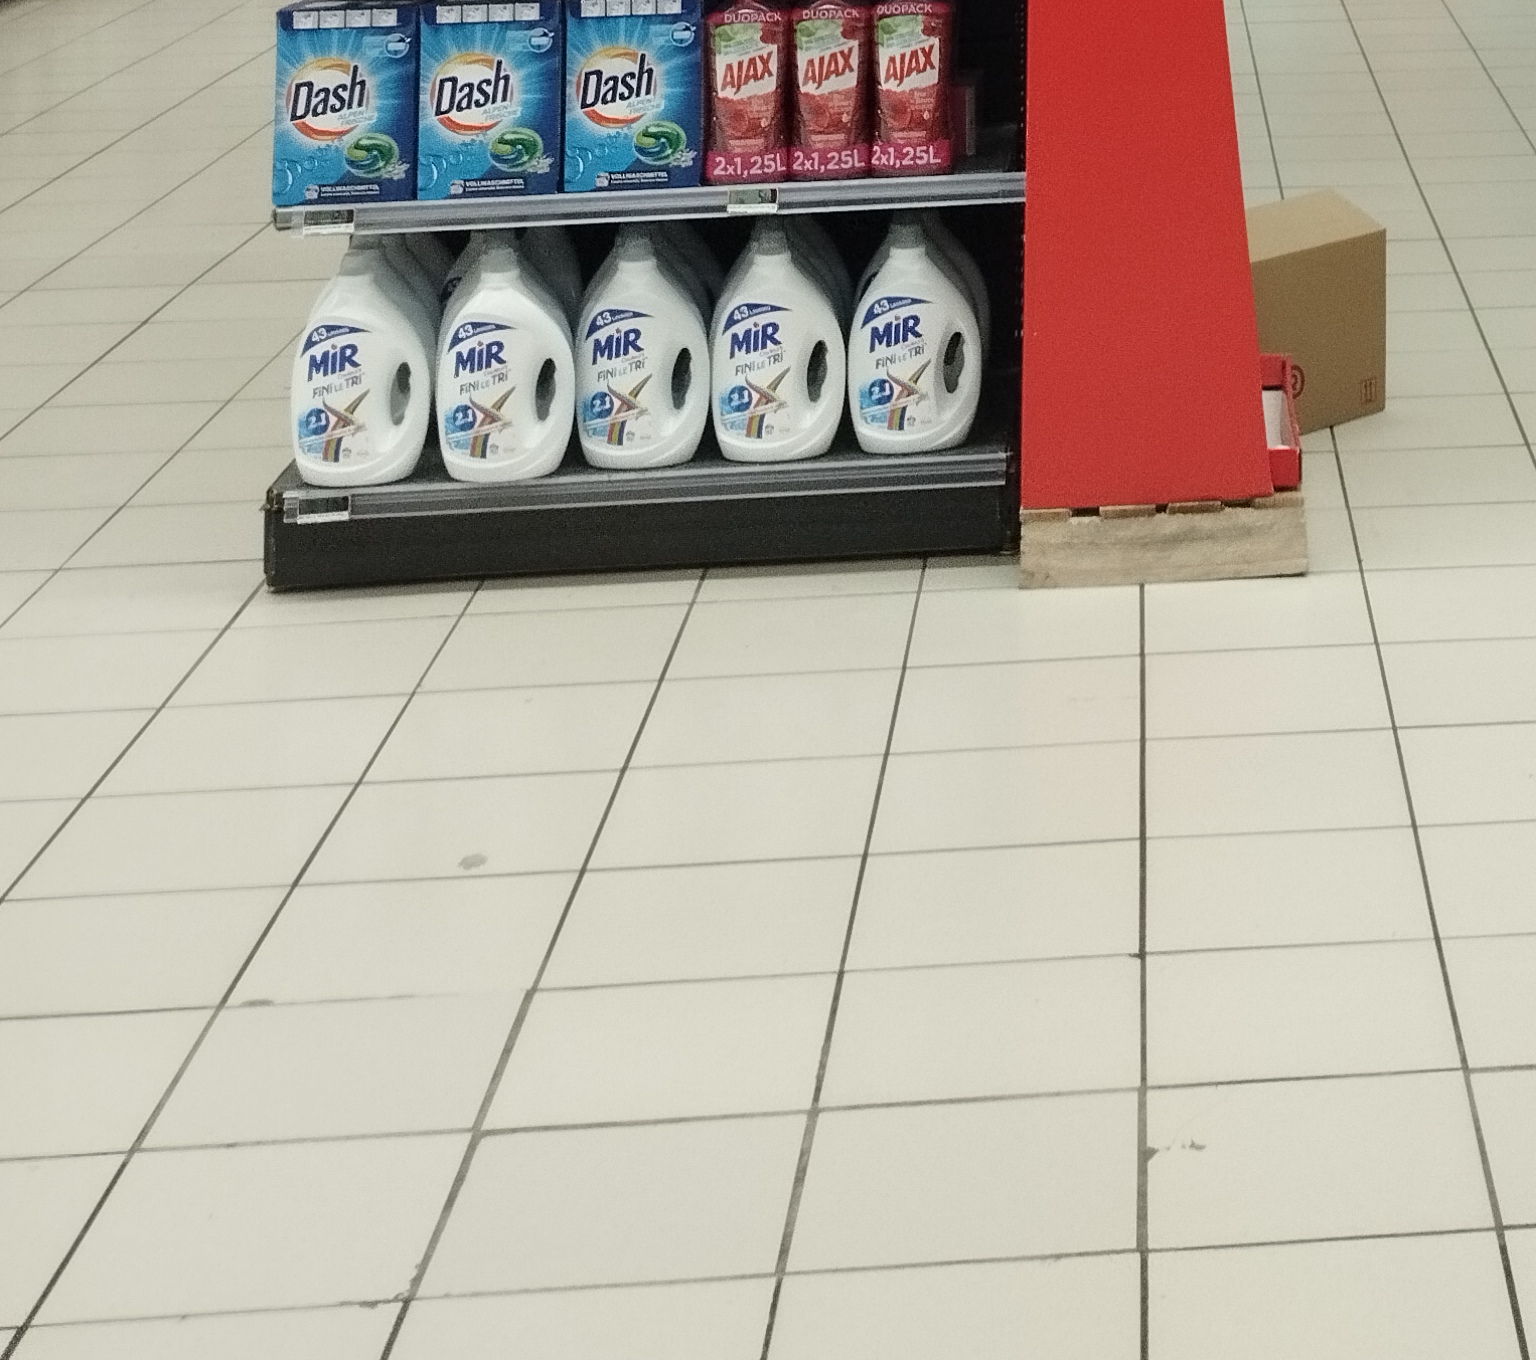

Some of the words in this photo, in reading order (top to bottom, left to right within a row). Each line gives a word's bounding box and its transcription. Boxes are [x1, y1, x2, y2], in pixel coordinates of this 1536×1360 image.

[724, 12, 781, 22] DUOPACK
[802, 9, 858, 19] DUOPACK
[581, 54, 654, 111] Dash
[721, 51, 774, 95] AJAX
[802, 47, 854, 90] AJAX
[884, 43, 935, 86] AJAX
[291, 65, 366, 122] Dash
[435, 60, 511, 116] Dash
